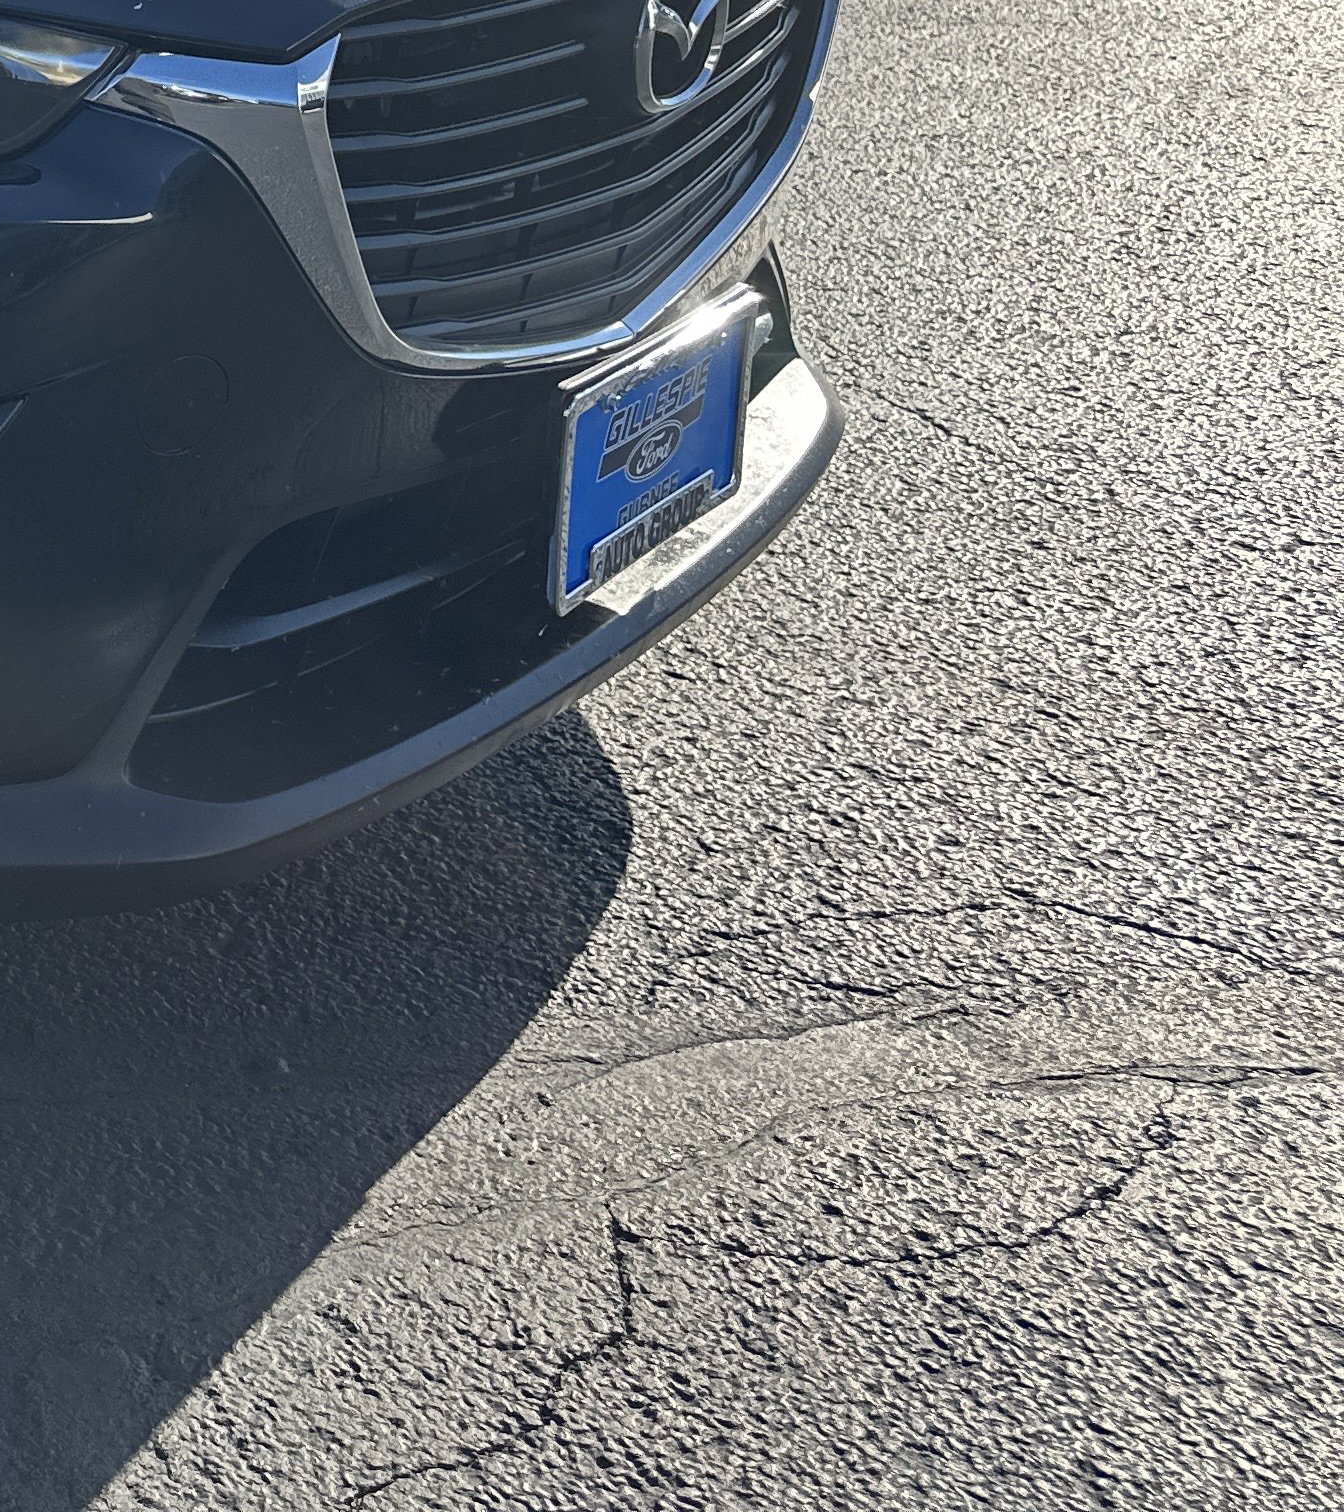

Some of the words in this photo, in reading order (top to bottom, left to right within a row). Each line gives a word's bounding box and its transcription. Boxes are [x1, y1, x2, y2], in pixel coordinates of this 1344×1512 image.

[604, 354, 714, 450] GILLESPIE
[635, 432, 672, 475] Ford
[601, 521, 646, 582] AUTO
[647, 483, 706, 549] GROUP
